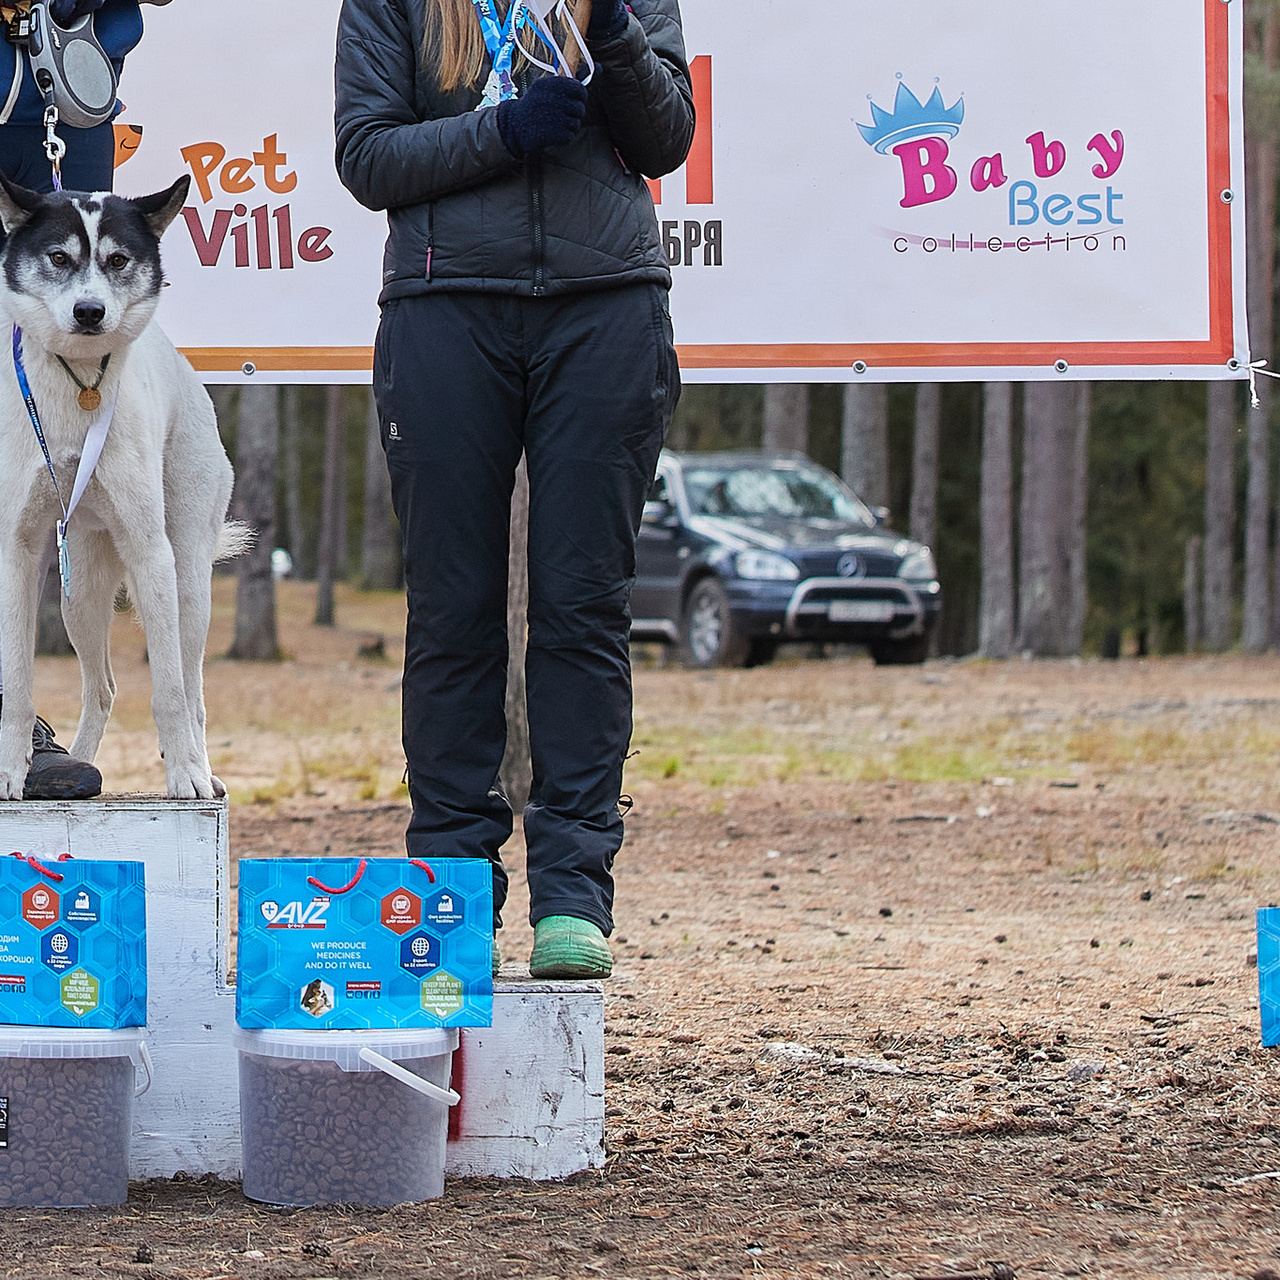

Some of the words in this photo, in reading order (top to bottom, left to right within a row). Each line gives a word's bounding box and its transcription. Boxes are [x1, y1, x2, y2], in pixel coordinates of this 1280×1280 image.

[180, 132, 298, 203] Pet
[892, 129, 1125, 208] Baby
[1008, 180, 1124, 225] Best
[179, 203, 334, 270] Ville
[893, 232, 1126, 253] collection
[270, 901, 330, 924] AVZ
[311, 941, 325, 949] WE
[327, 941, 366, 949] PRODUCE
[316, 951, 361, 960] MEDICINES
[305, 961, 323, 969] AND
[324, 961, 338, 969] DO
[339, 961, 347, 969] IT
[349, 961, 372, 969] WELL
